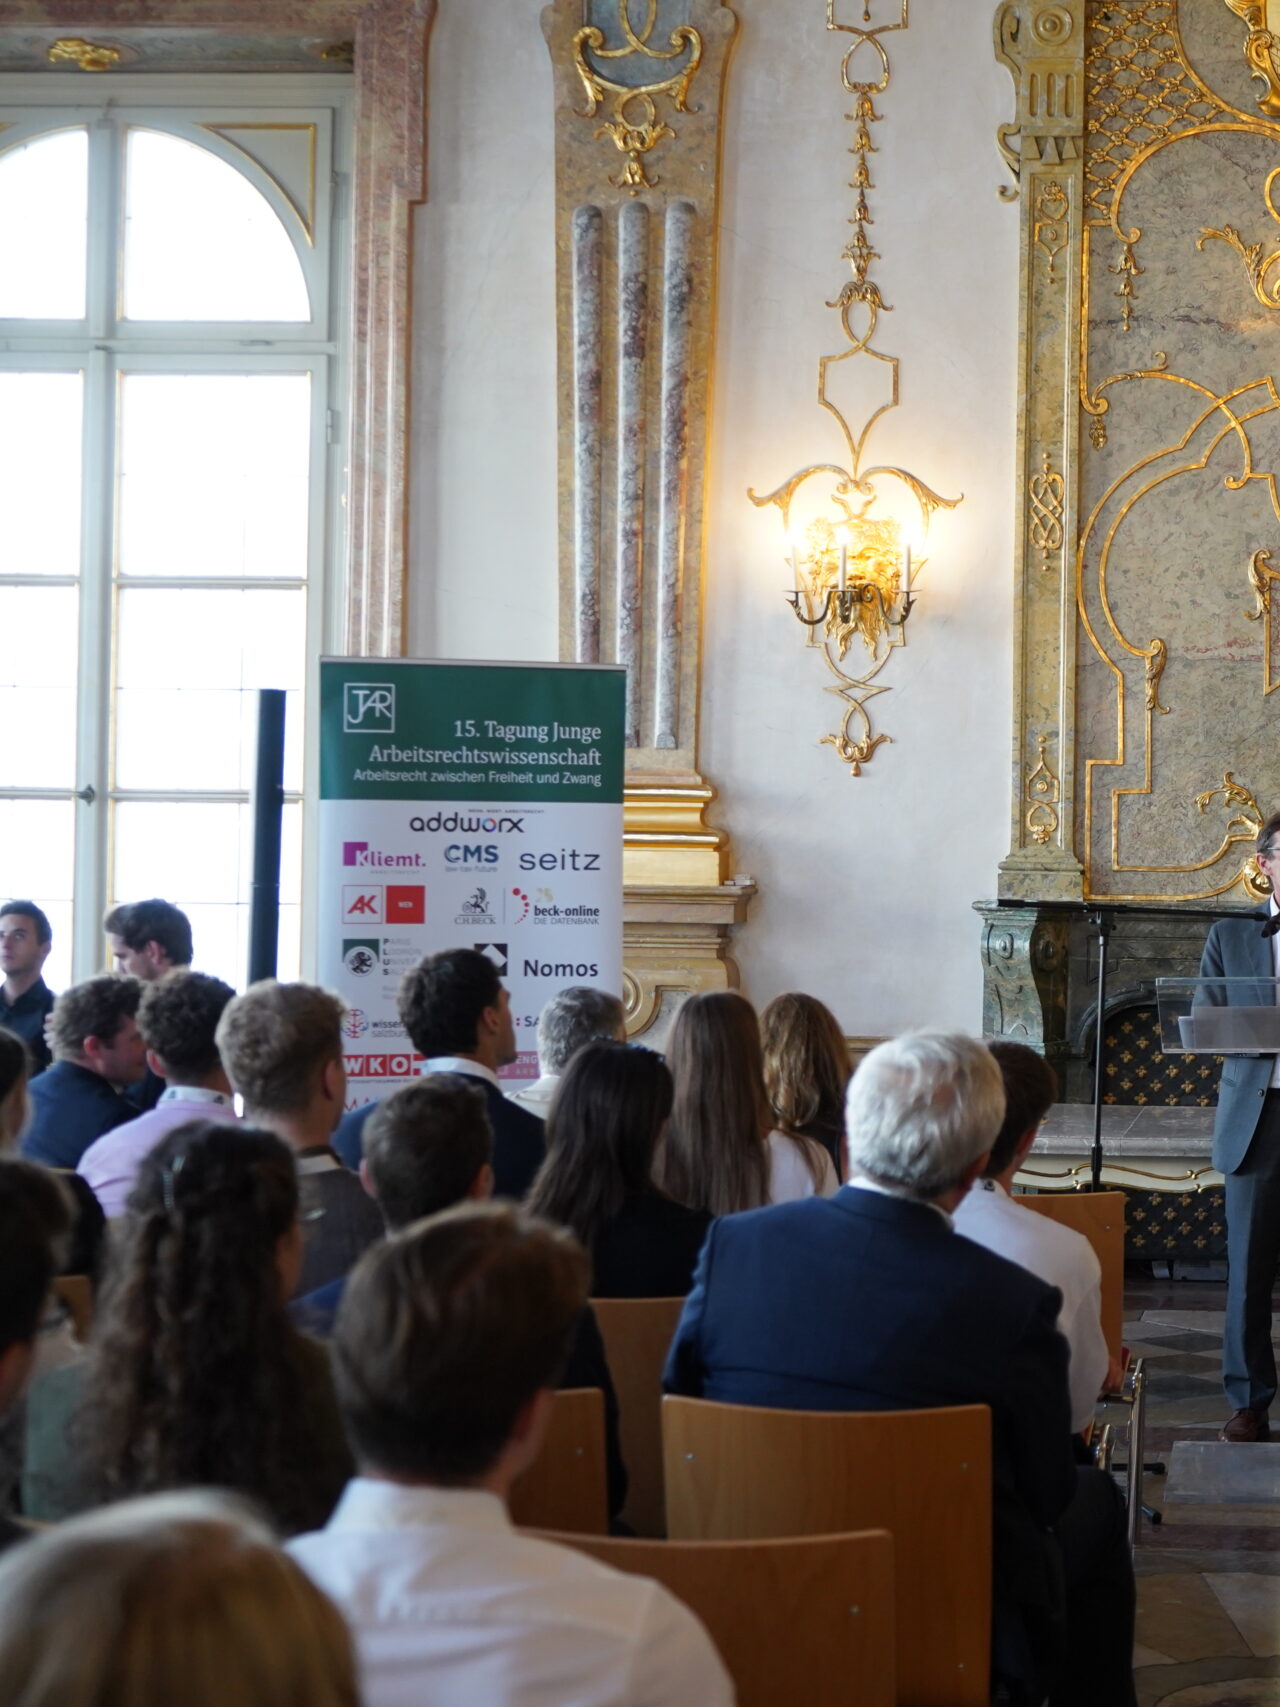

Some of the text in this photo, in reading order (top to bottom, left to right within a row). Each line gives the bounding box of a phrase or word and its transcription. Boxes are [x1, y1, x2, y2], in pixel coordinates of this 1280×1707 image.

[454, 720, 602, 744] 15. Tagung Junge
[369, 744, 602, 765] Arbeitsrechtswissenschaft
[353, 768, 602, 788] Arbeitsrecht zwischen Freiheit und Zwang
[410, 812, 525, 833] addworx
[444, 844, 499, 863] CMS
[519, 848, 601, 871] seitz
[347, 895, 378, 914] AK
[534, 905, 600, 917] beck-online
[534, 917, 600, 925] DIE DATENBANK
[524, 959, 599, 977] Nomos
[343, 1056, 408, 1074] WKO
